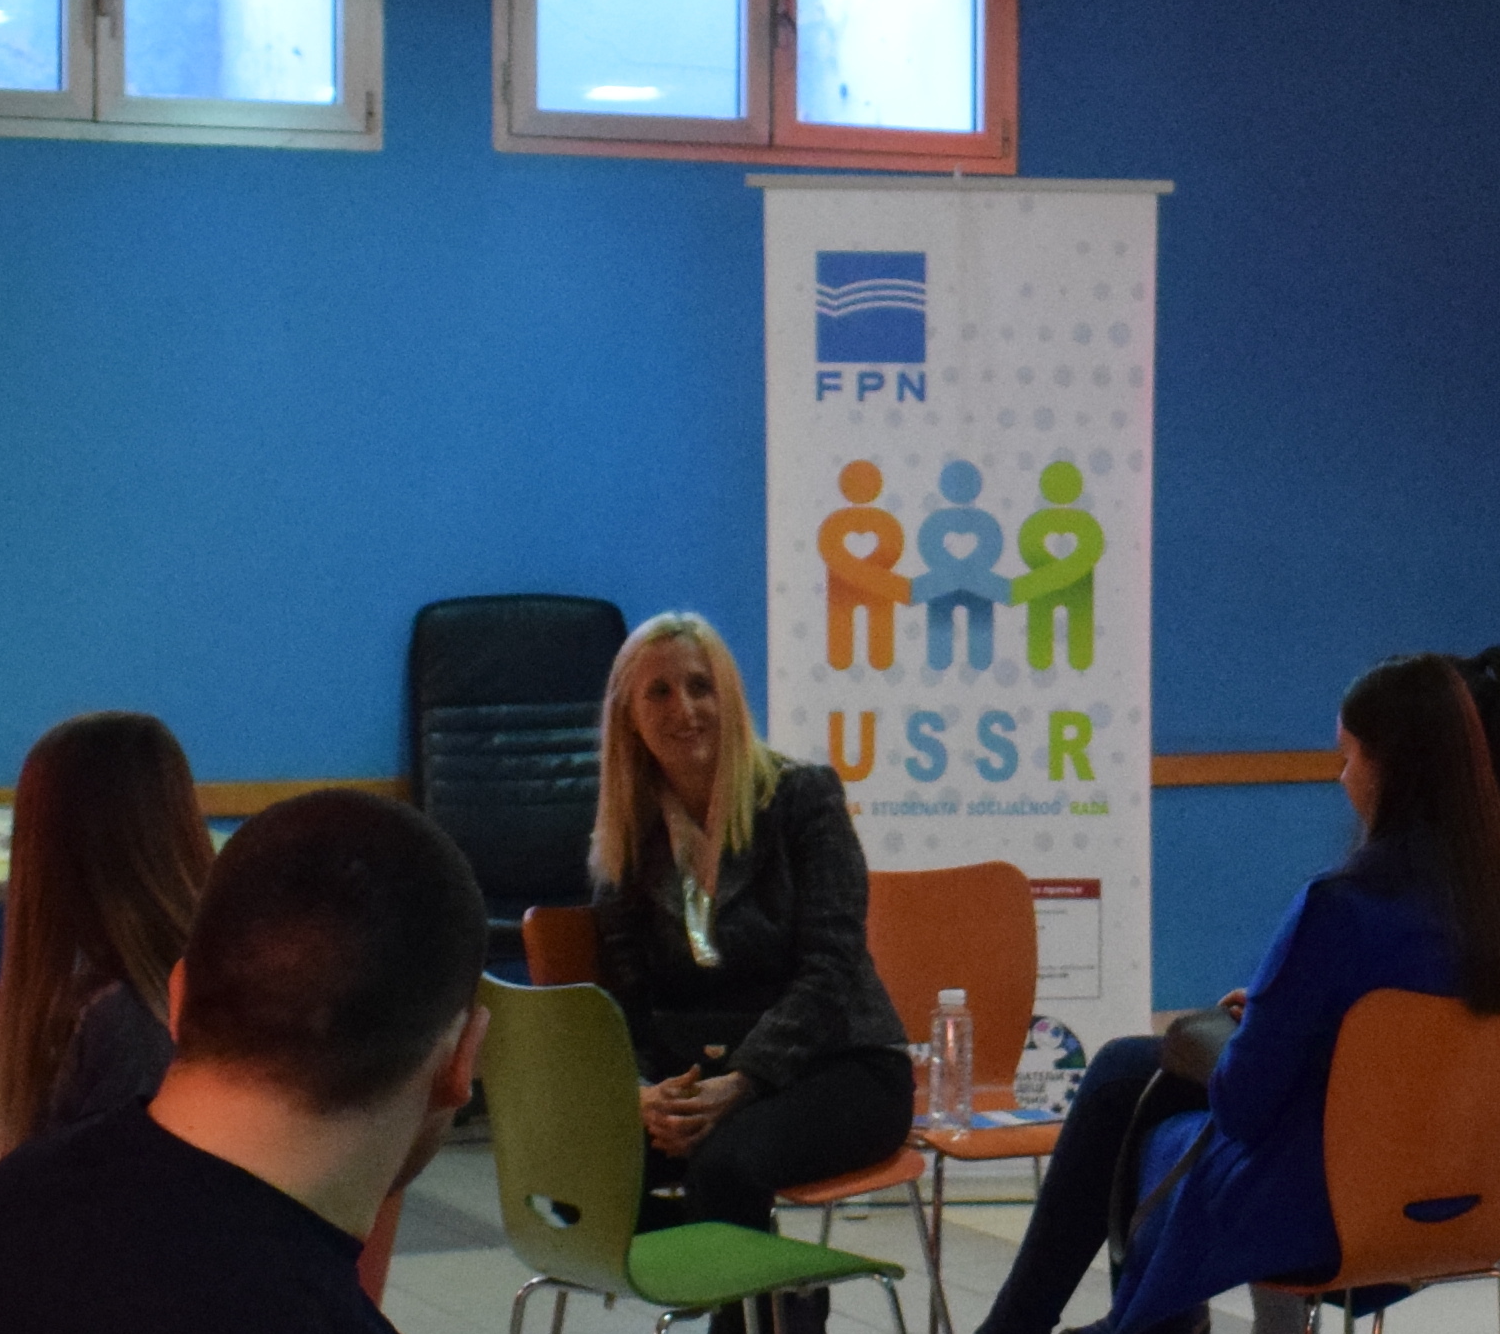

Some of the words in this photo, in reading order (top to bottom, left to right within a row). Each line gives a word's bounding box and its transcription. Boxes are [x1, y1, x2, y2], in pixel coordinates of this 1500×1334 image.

[816, 370, 927, 403] FPN
[827, 709, 1095, 783] USSR
[1069, 801, 1109, 816] RADA
